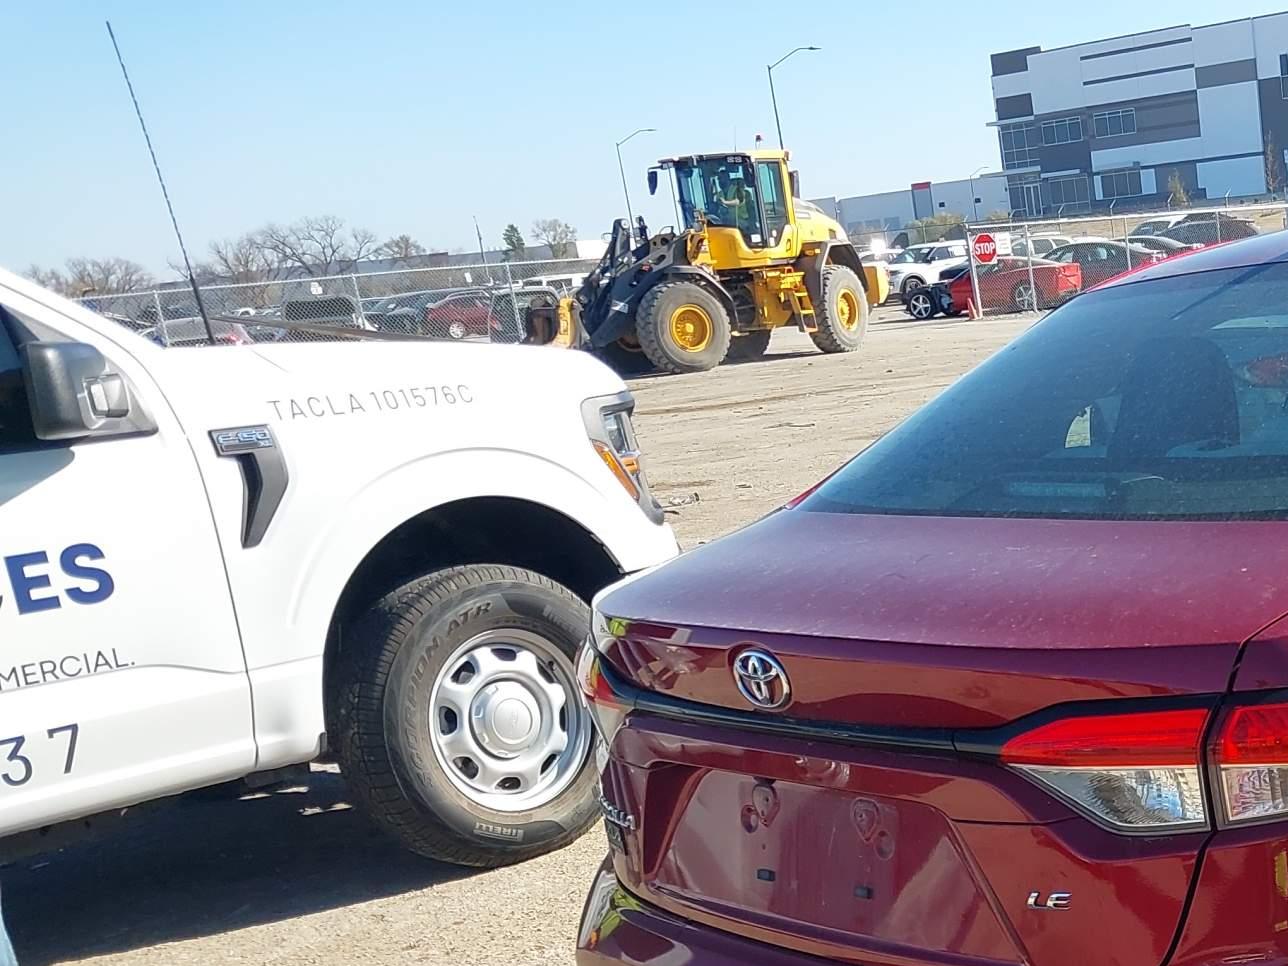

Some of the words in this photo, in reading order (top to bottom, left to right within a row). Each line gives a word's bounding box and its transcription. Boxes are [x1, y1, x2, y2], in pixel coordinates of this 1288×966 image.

[974, 242, 995, 255] STOP
[0, 542, 115, 616] ES
[447, 602, 492, 638] ATR
[1027, 891, 1072, 910] LE
